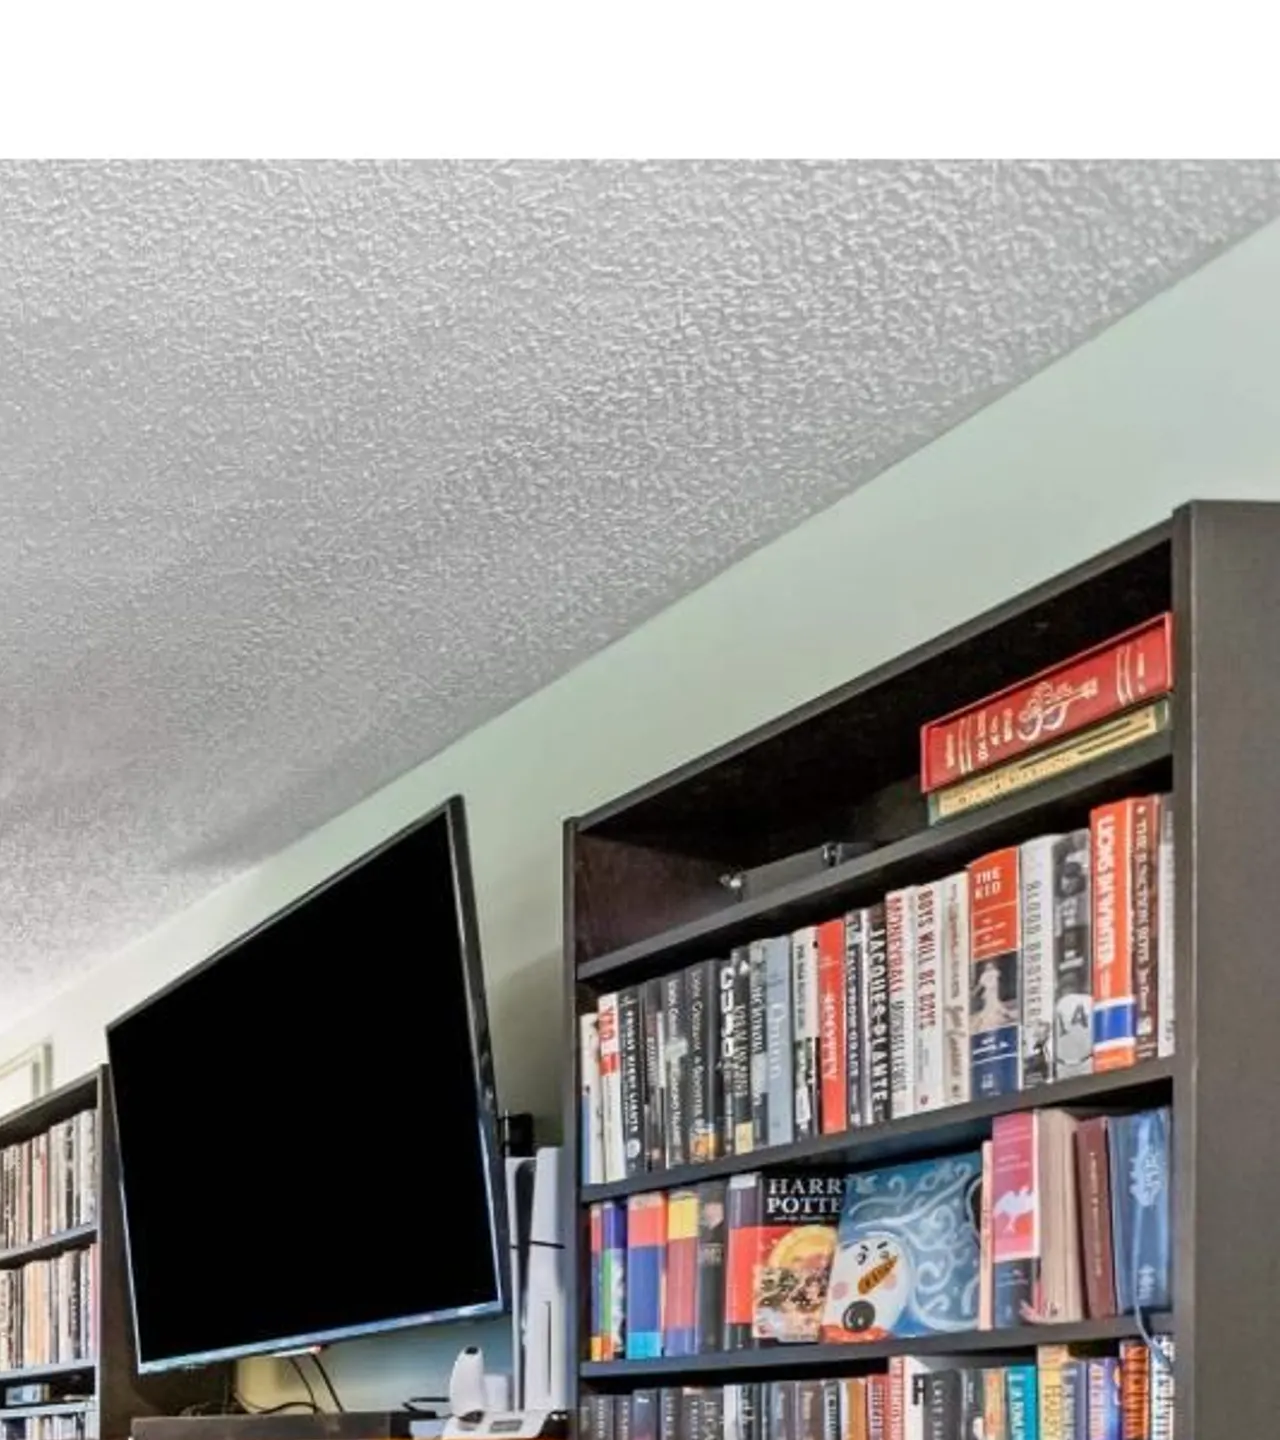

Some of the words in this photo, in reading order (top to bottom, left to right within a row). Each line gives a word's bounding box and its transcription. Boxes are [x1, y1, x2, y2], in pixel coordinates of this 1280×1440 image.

[974, 865, 1002, 885] THE
[974, 881, 1002, 900] KID
[918, 889, 934, 928] BOYS
[1025, 880, 1043, 936] BLOOD
[918, 932, 936, 966] WILL
[870, 928, 886, 1006] JACQUES
[918, 969, 936, 988] BE
[918, 993, 936, 1031] BOYS
[871, 1023, 887, 1102] PLANTE
[766, 1197, 843, 1214] POTTE
[931, 1380, 944, 1414] LAST
